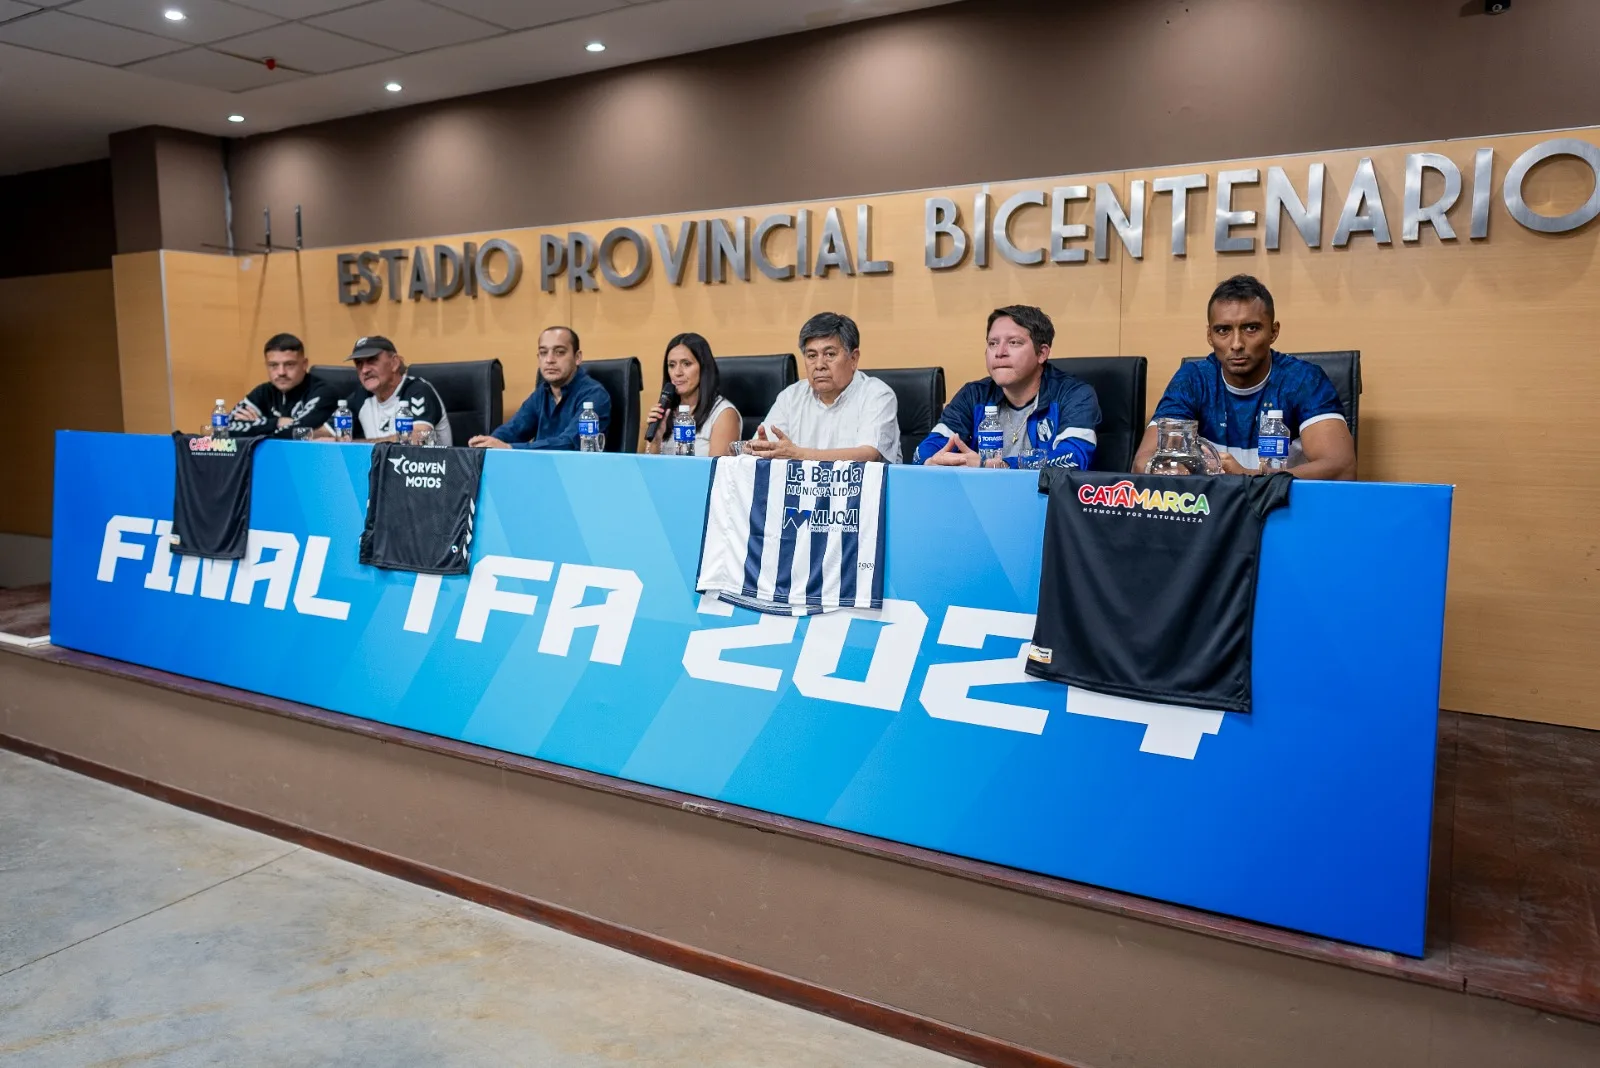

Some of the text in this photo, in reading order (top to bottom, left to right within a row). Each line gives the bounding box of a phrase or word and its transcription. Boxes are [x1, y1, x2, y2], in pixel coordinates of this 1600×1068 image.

[336, 138, 1600, 304] ESTADIO PROVINCIAL BICENTENARIO
[402, 459, 446, 475] CORVEN
[787, 463, 862, 483] La Banda
[406, 476, 442, 489] MOTOS
[786, 484, 860, 497] MUNICIPALIDAD
[1078, 480, 1211, 516] CATAMARCA
[811, 509, 859, 525] MIJOVI
[1083, 507, 1122, 516] HERMOSA
[1146, 514, 1203, 524] NATURALEZA
